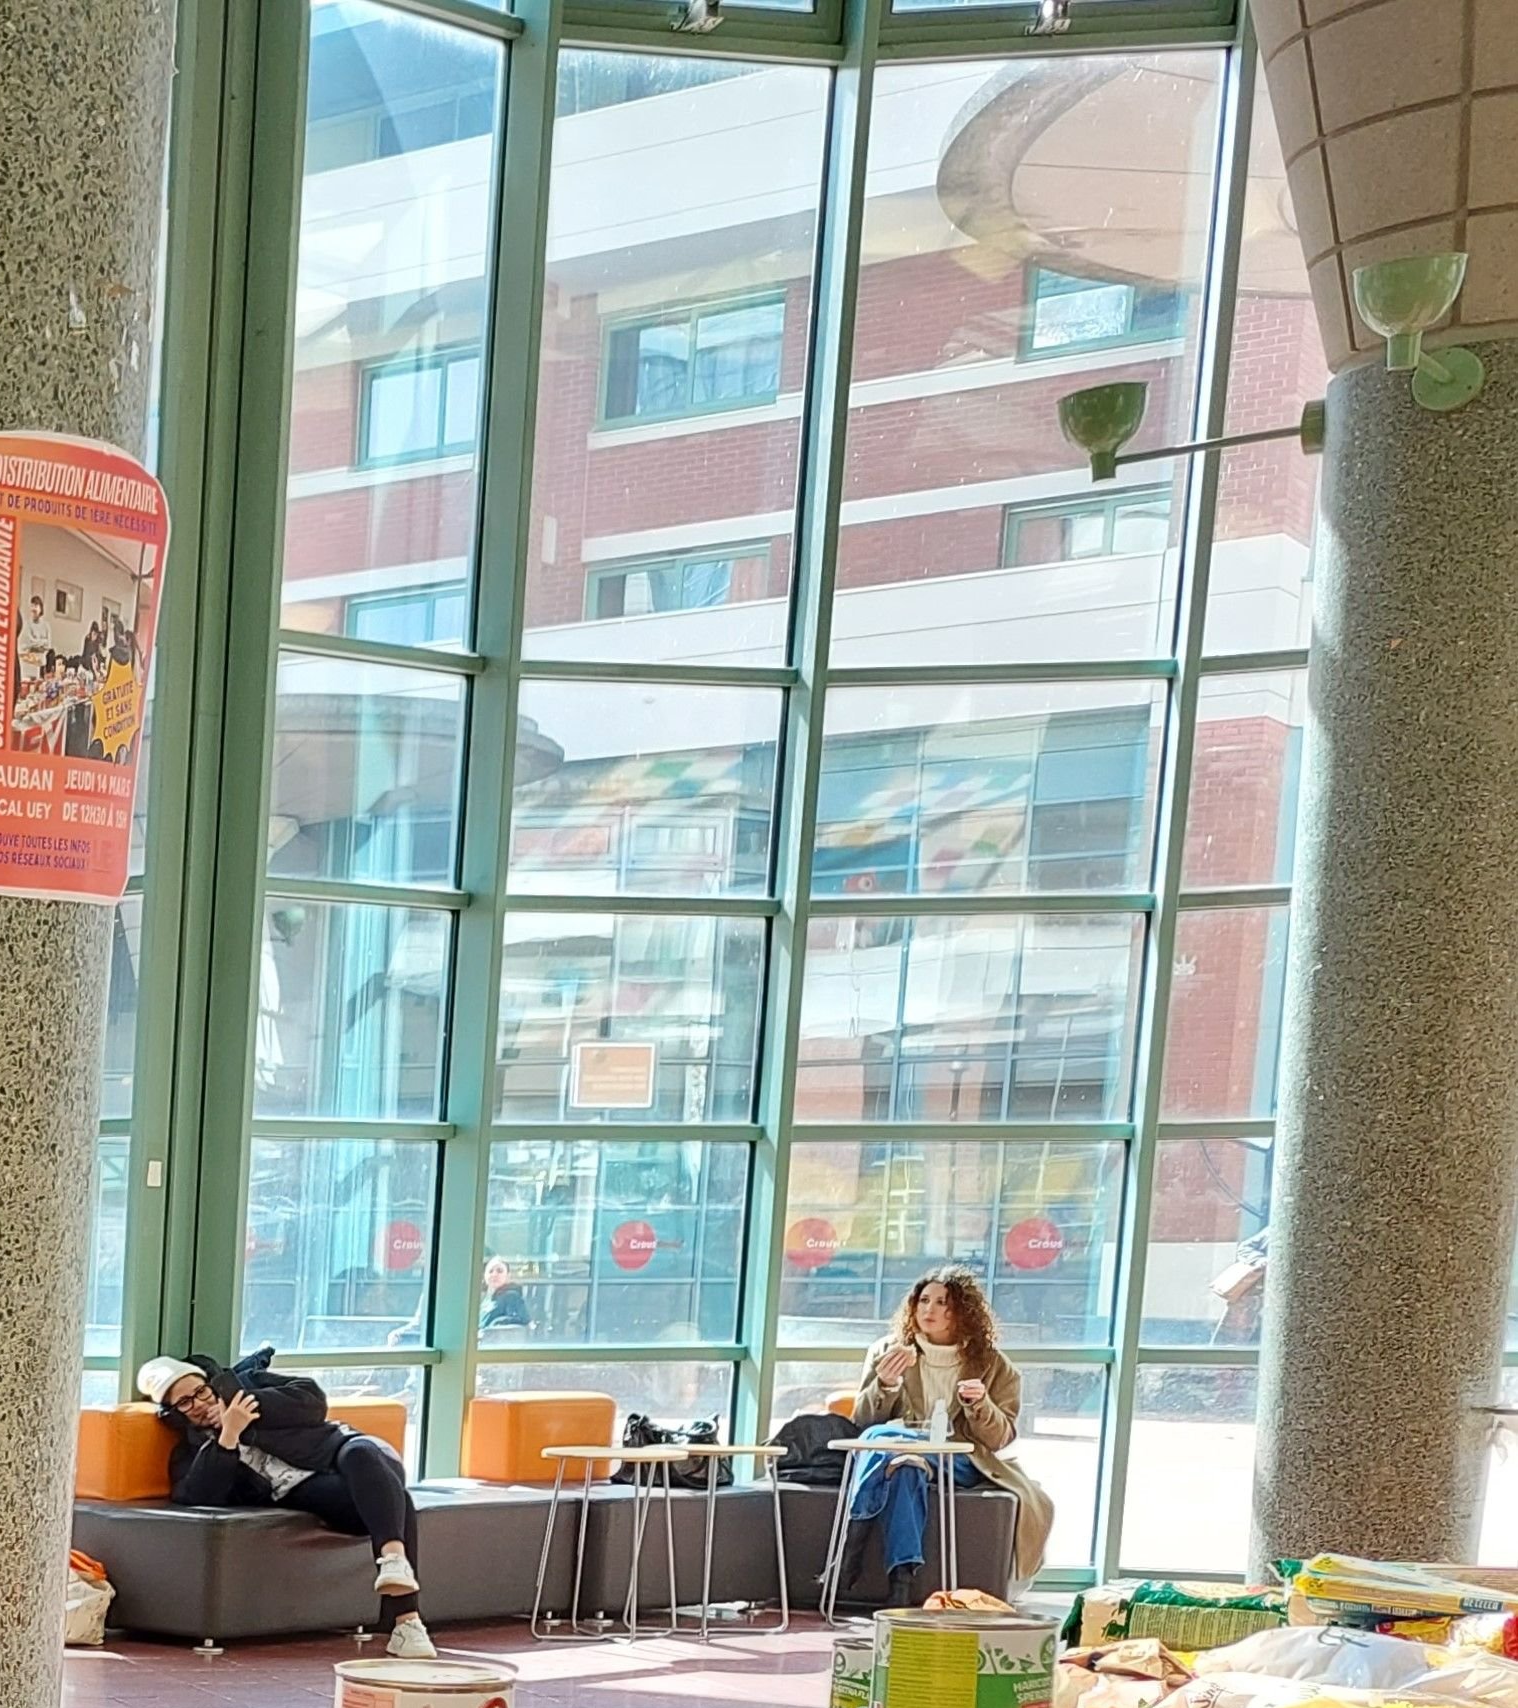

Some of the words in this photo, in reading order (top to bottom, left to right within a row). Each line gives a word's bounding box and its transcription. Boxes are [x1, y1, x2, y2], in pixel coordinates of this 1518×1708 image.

[84, 470, 158, 514] ALIMENTAIRE
[8, 496, 20, 509] DE
[24, 498, 71, 517] PRODUITS
[75, 506, 87, 520] DE
[65, 770, 94, 792] JEUDI
[97, 774, 106, 793] 14
[109, 776, 131, 797] MARS
[27, 801, 52, 819] UEY
[63, 802, 77, 822] DE
[80, 805, 106, 824] 12H30
[22, 835, 52, 849] TOUTES
[54, 840, 68, 851] LES
[70, 841, 91, 854] INFOS
